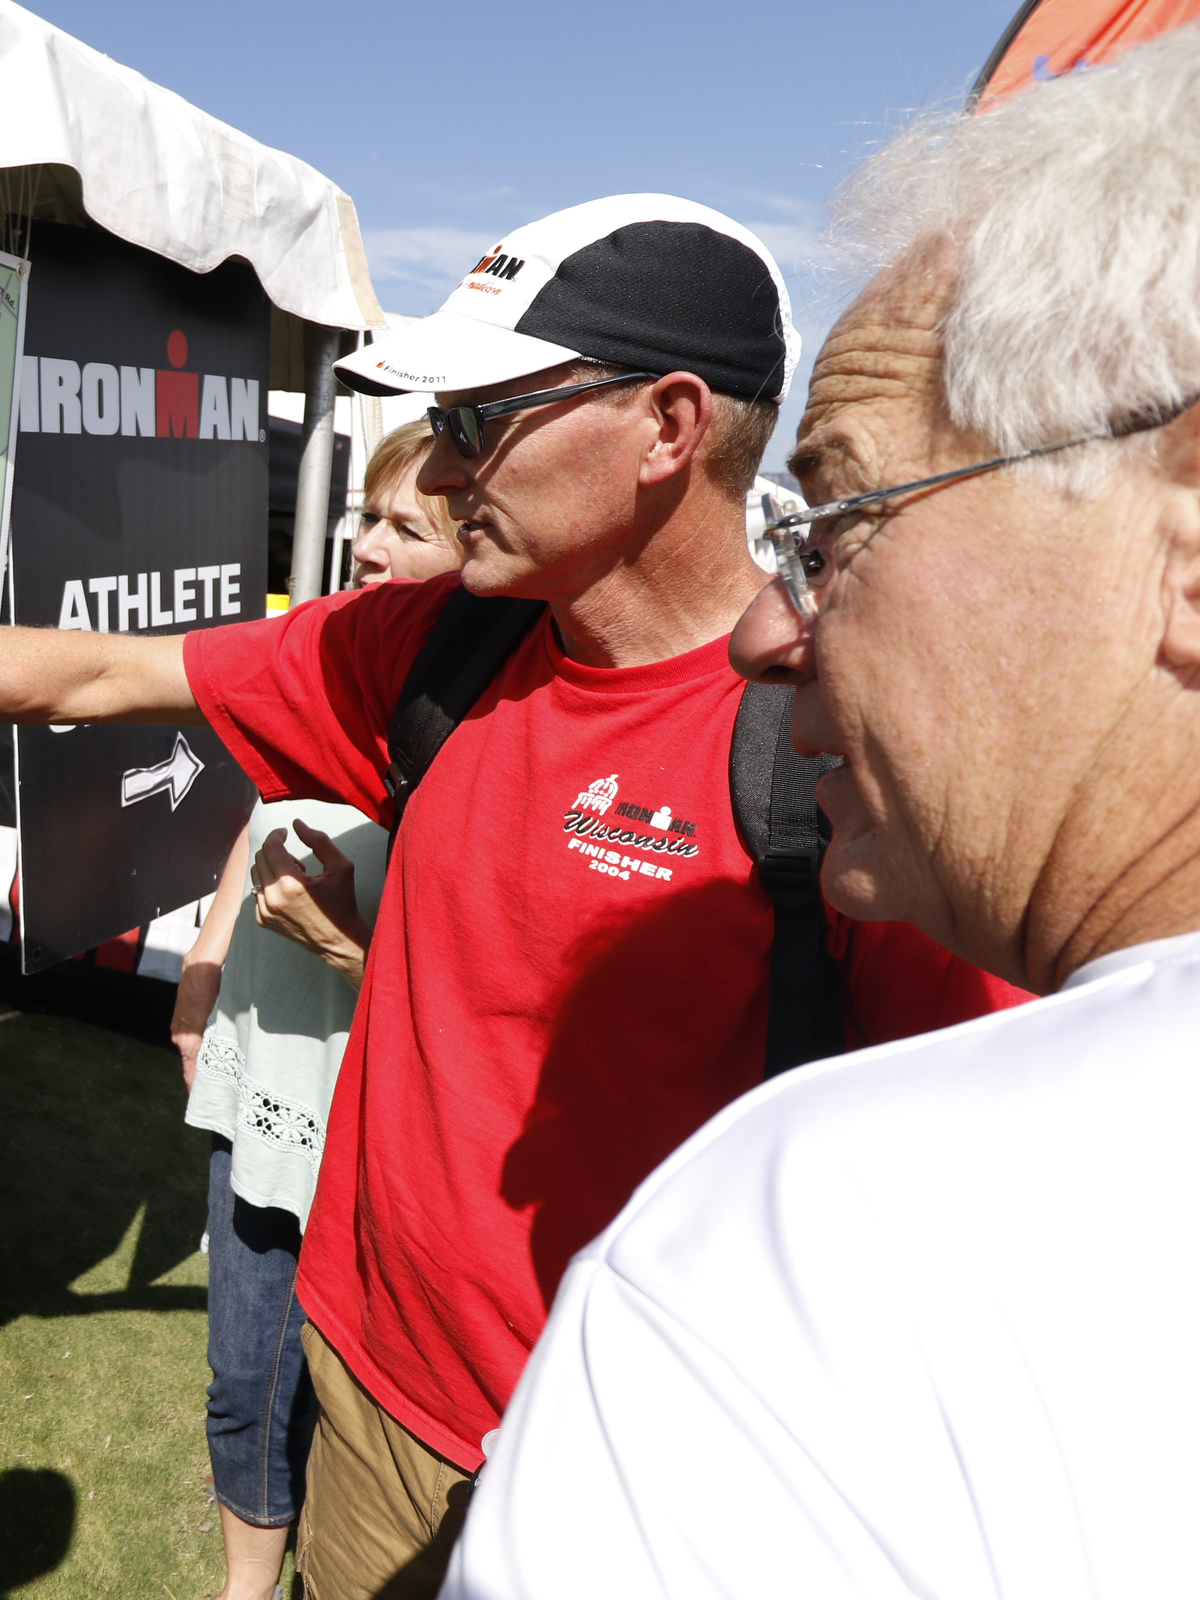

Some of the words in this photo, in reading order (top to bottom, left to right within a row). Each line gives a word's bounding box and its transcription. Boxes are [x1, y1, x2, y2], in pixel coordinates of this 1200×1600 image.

[4, 292, 16, 310] Rd.
[19, 342, 260, 441] IRONMAN
[383, 365, 421, 382] Finisher
[421, 375, 446, 384] 2011
[58, 563, 241, 633] ATHLETE
[563, 811, 699, 858] Wisconsin
[567, 838, 673, 881] FINISHER
[588, 860, 630, 881] 2004
